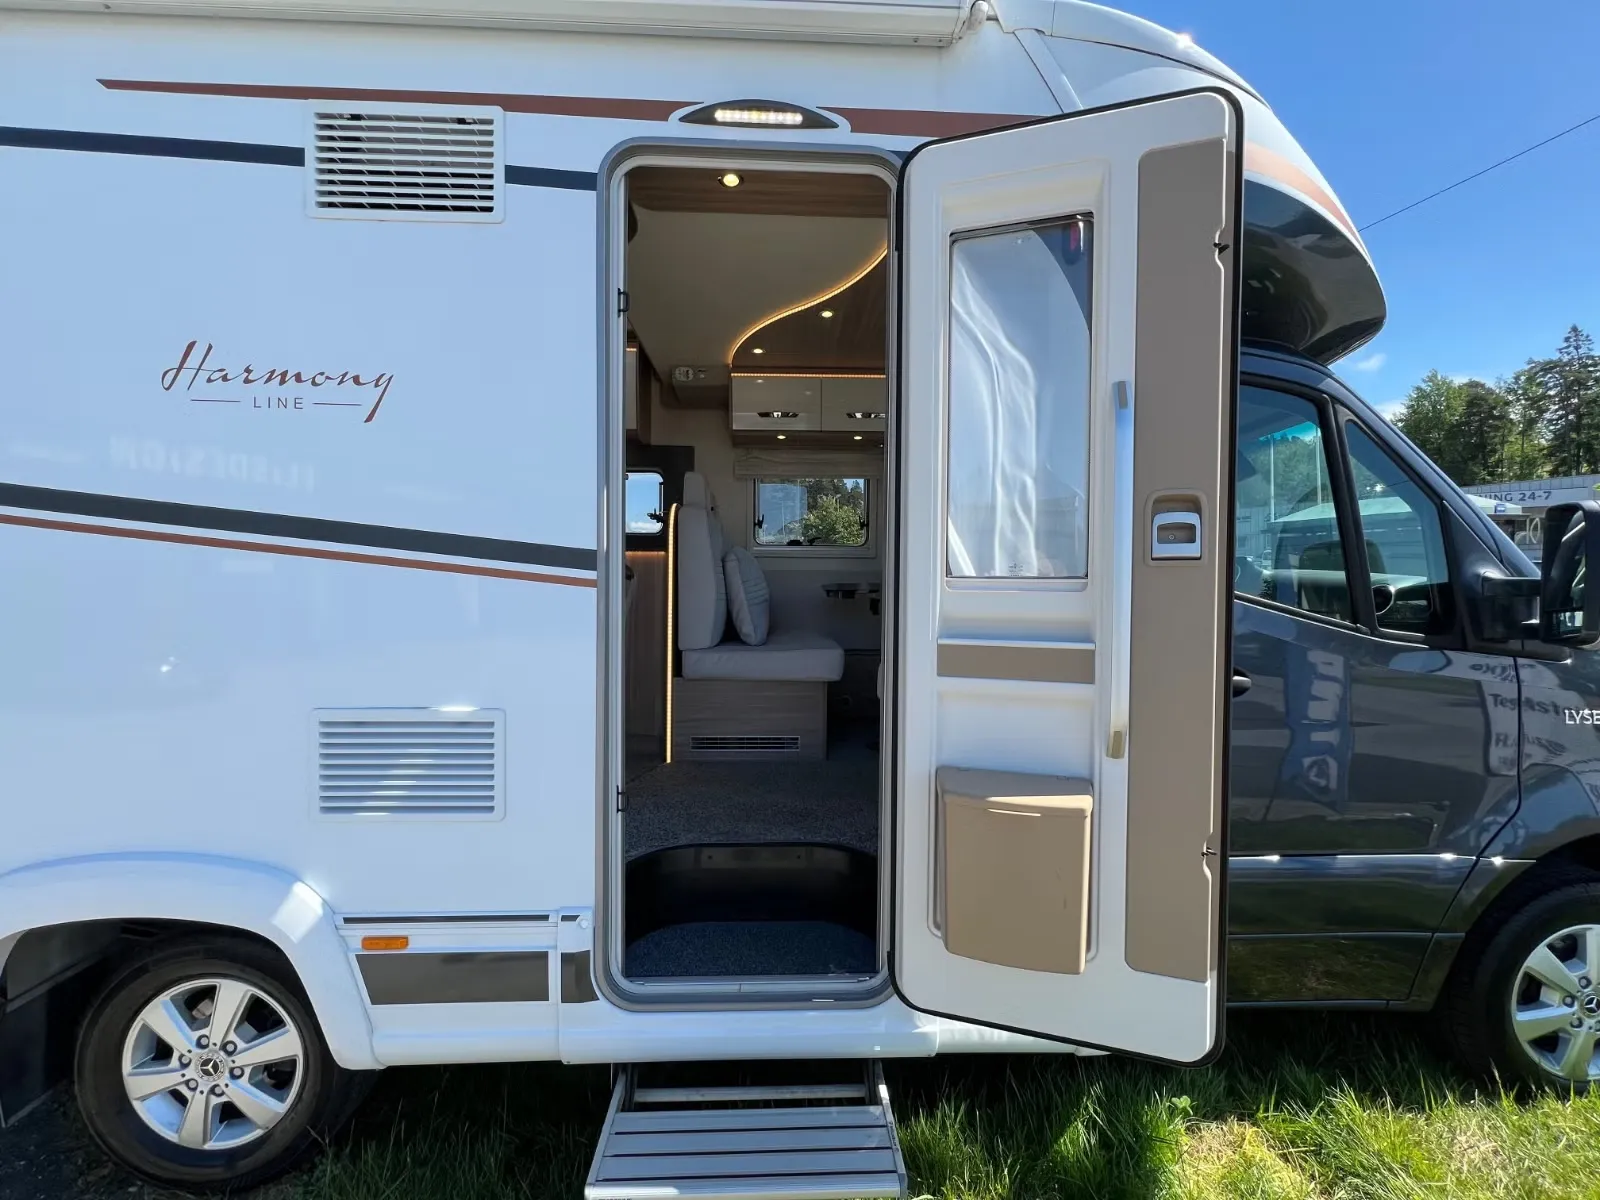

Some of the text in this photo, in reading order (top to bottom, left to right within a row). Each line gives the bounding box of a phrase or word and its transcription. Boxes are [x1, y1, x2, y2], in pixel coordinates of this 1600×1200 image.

[161, 340, 394, 424] Harmony
[253, 396, 304, 410] LINE
[1518, 491, 1552, 502] 24-7
